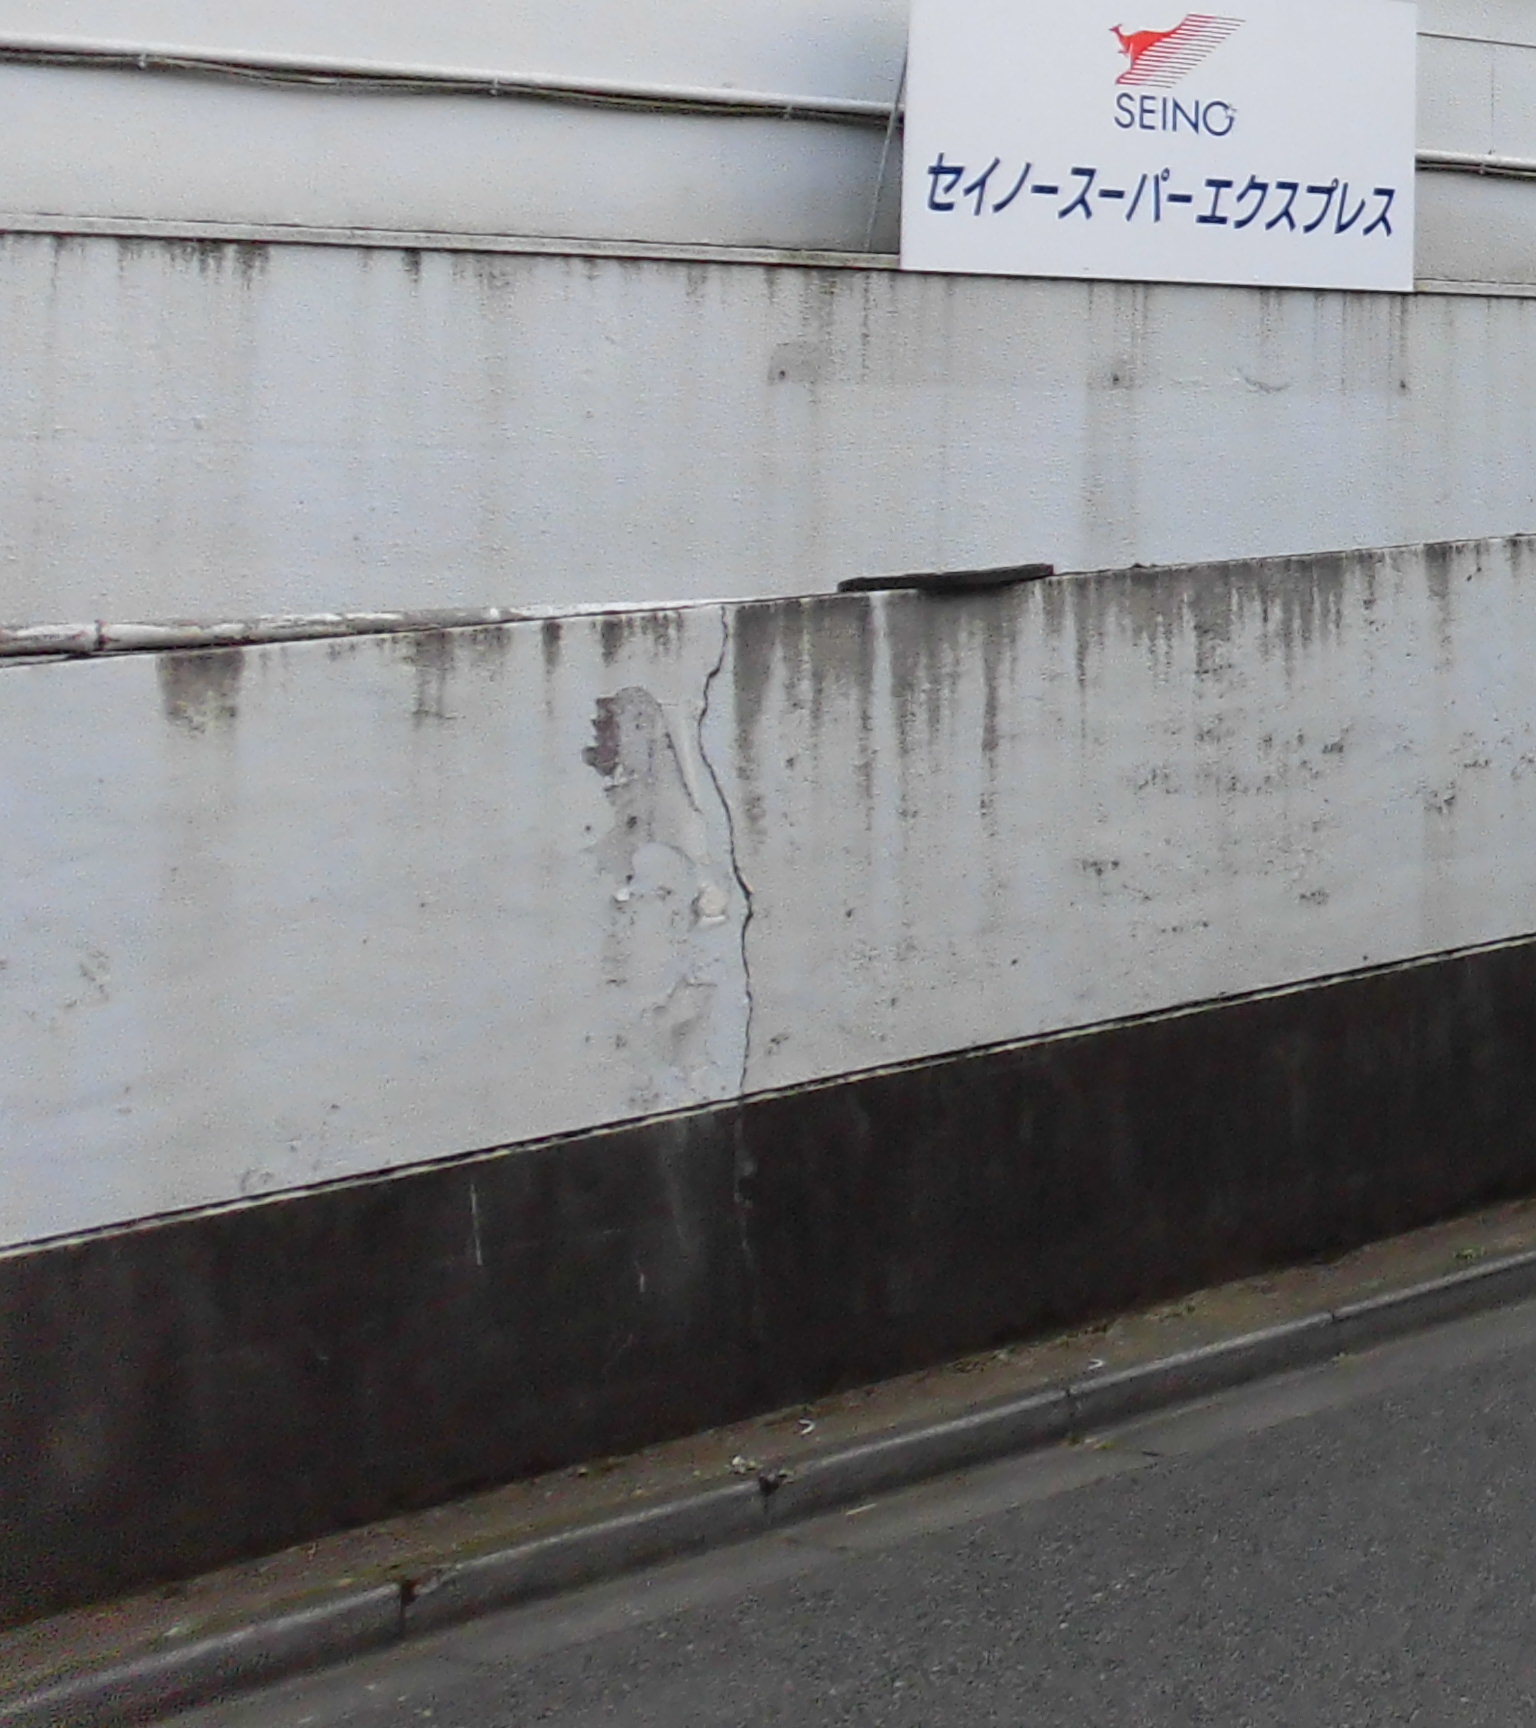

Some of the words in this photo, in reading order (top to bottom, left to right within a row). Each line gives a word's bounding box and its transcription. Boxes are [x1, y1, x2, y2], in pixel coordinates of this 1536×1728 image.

[1113, 92, 1238, 136] SEINO
[926, 152, 1396, 238] セイノースーパーエクスプレス
